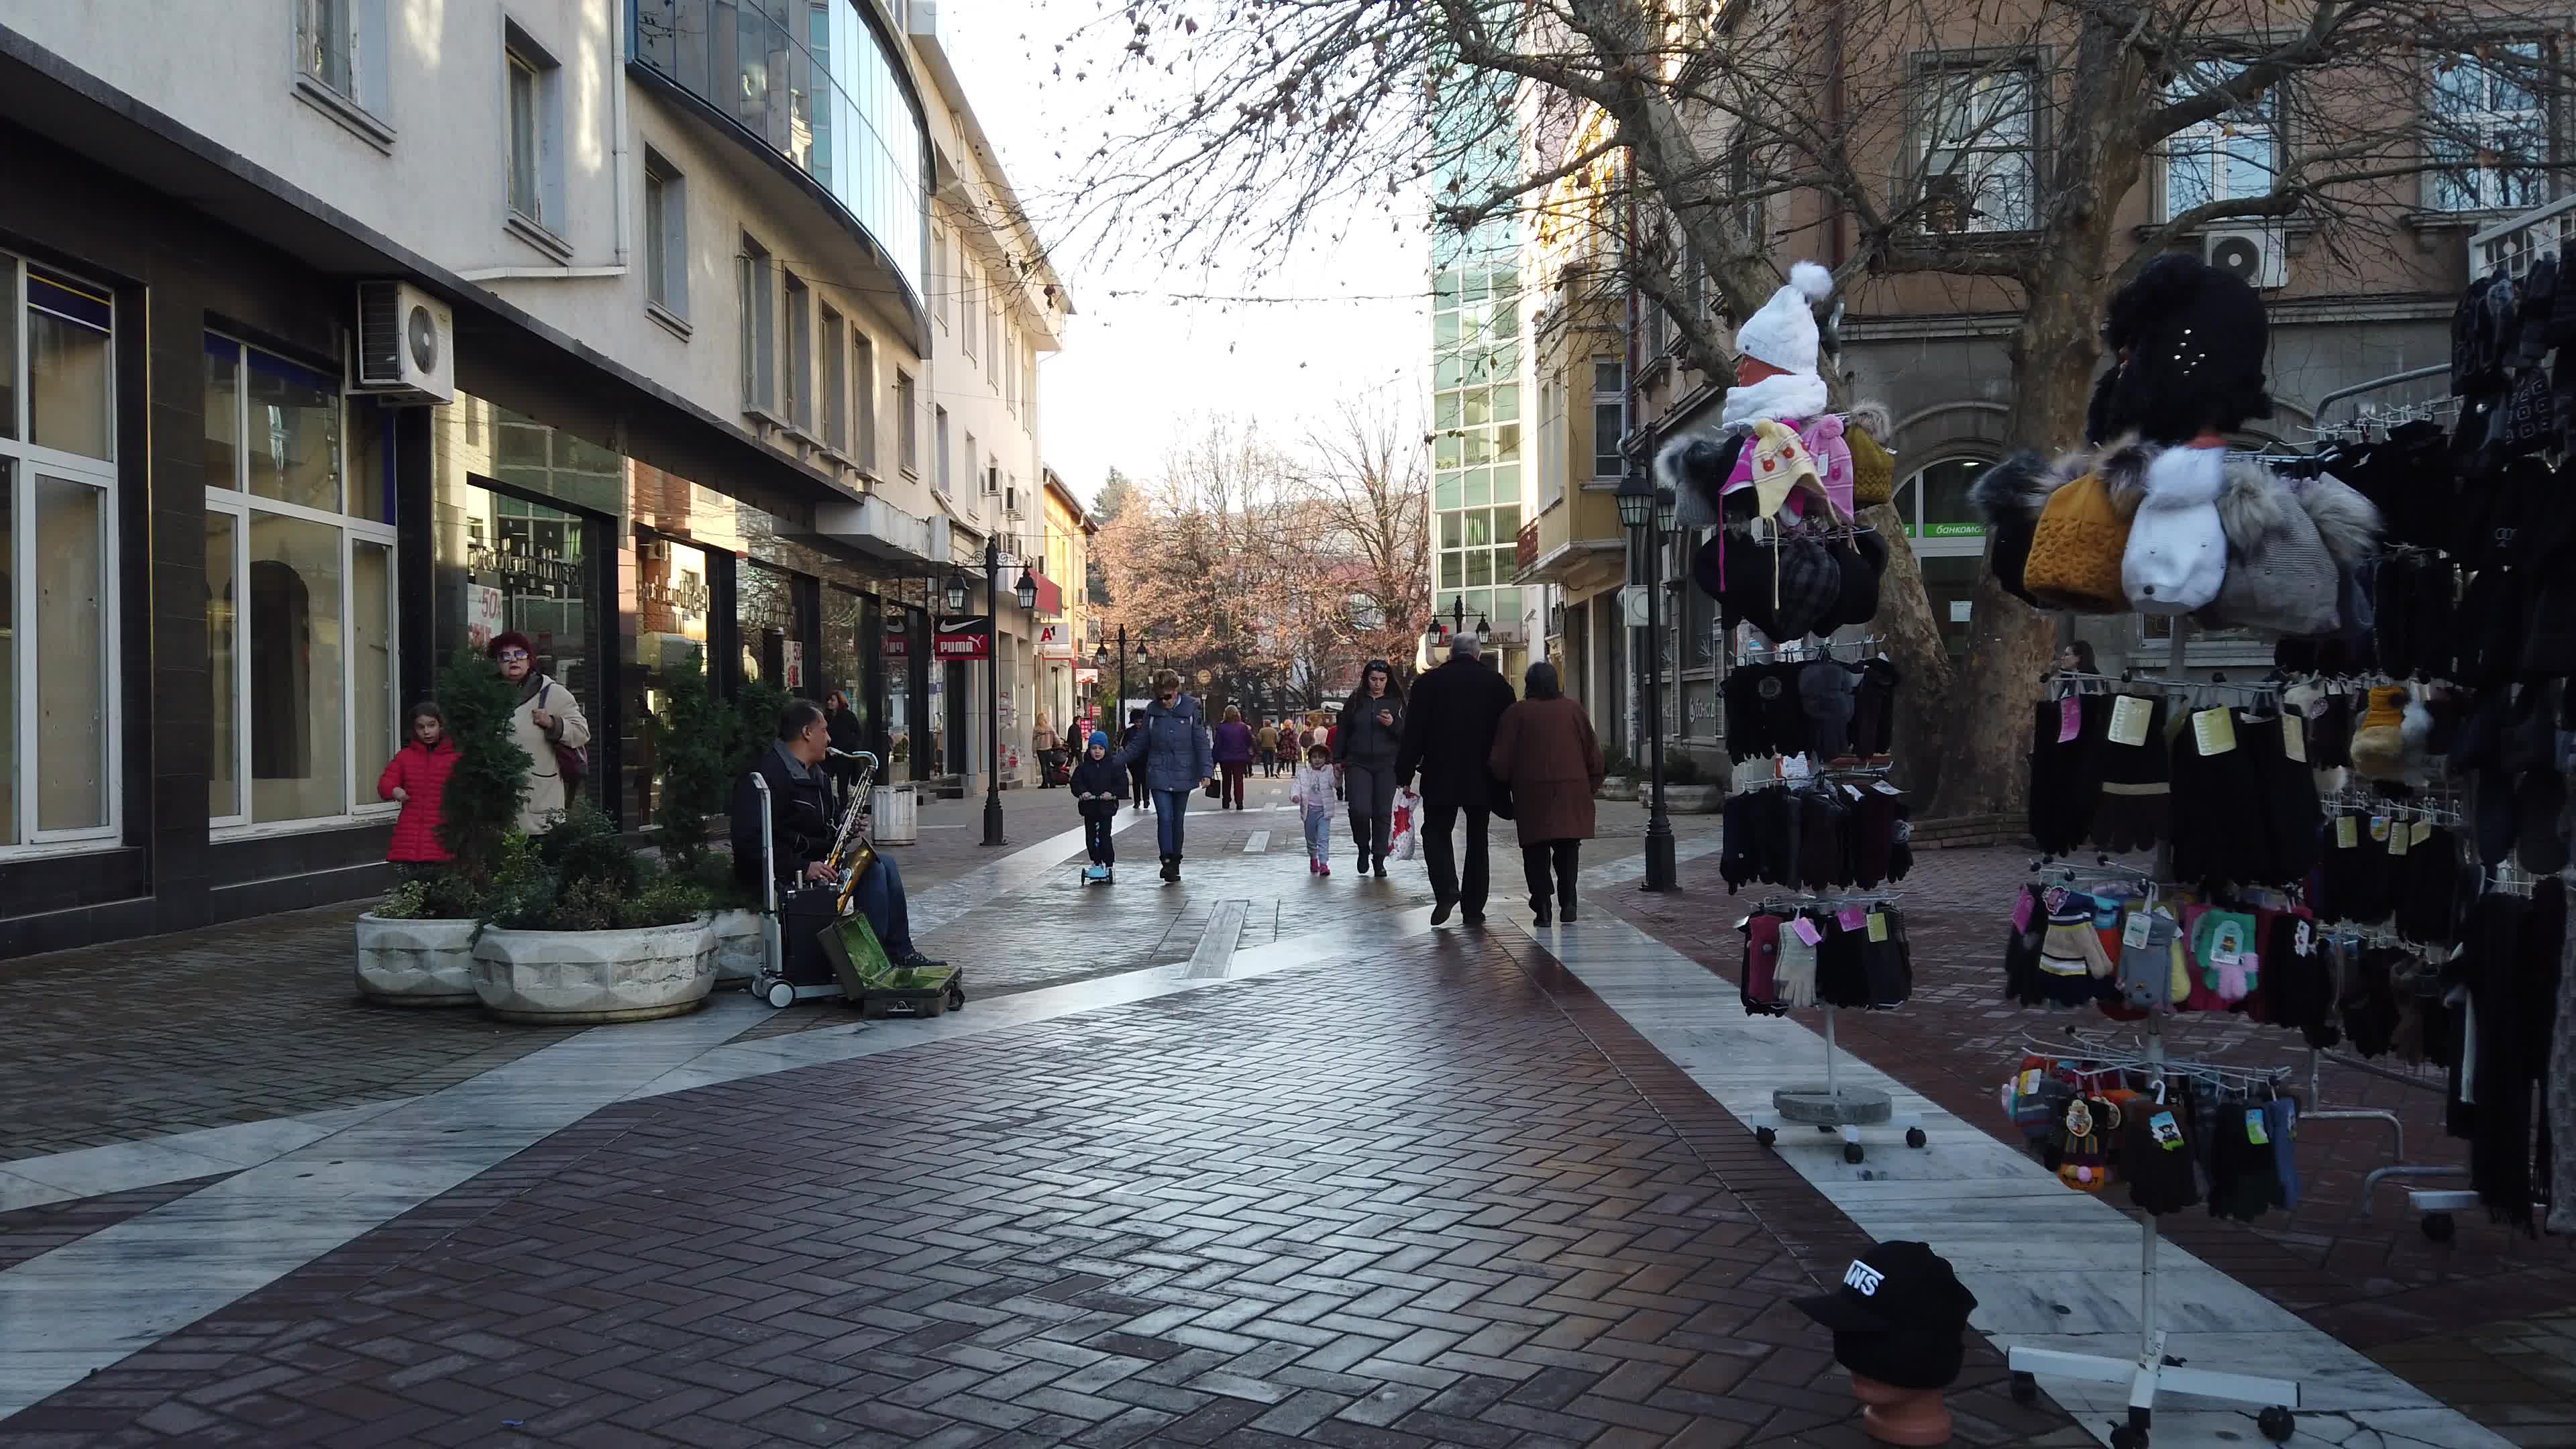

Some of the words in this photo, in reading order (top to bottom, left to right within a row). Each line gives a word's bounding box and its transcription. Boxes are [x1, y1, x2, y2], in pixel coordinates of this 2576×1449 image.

[1936, 525, 1986, 535] банкома
[1040, 625, 1056, 642] A1
[940, 641, 973, 653] PUMA
